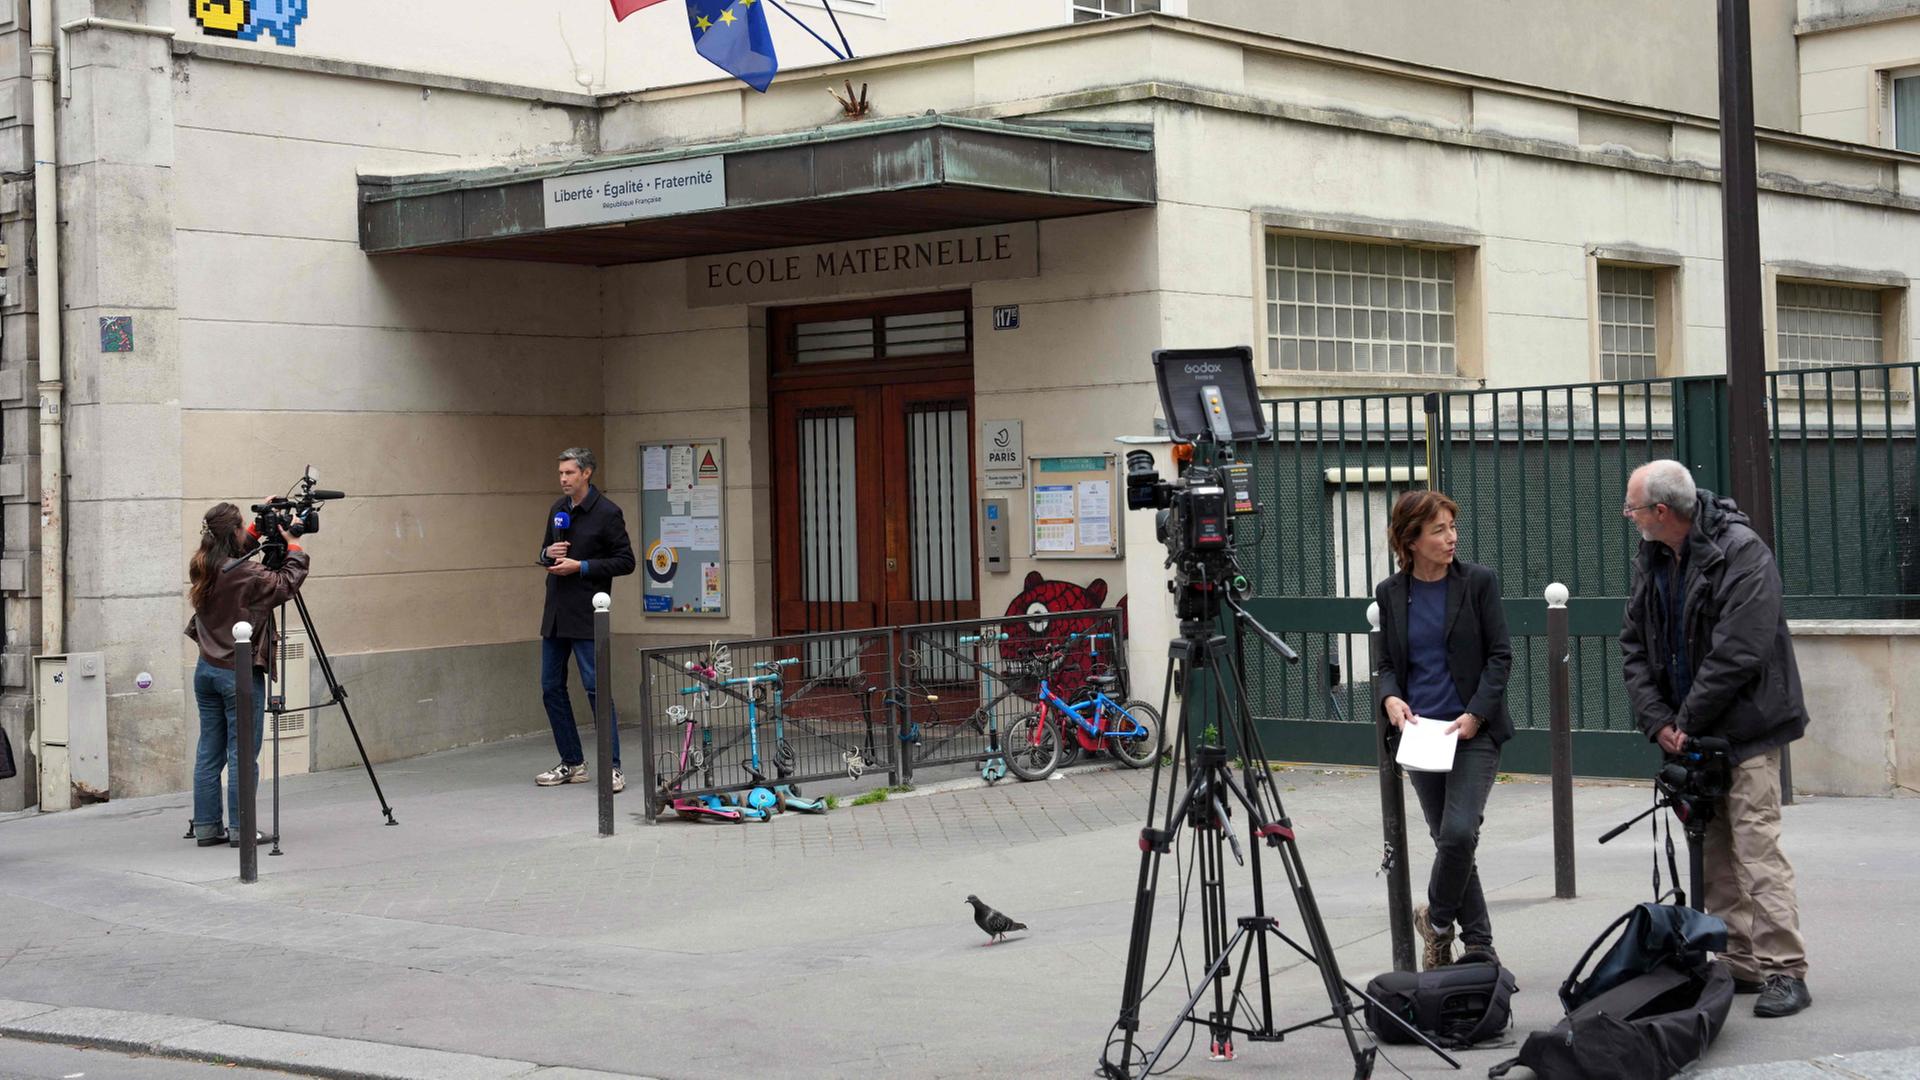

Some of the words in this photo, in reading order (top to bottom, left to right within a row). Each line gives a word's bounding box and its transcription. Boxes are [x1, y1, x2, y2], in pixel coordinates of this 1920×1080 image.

[554, 186, 593, 203] Liberté
[604, 179, 643, 198] Égalité
[654, 170, 713, 190] Fraternité
[602, 200, 634, 209] République
[635, 196, 662, 205] Française
[708, 256, 801, 288] ECOLE
[816, 234, 1013, 278] MATERNELLE
[1184, 362, 1222, 373] Godox
[989, 452, 1016, 462] PARIS
